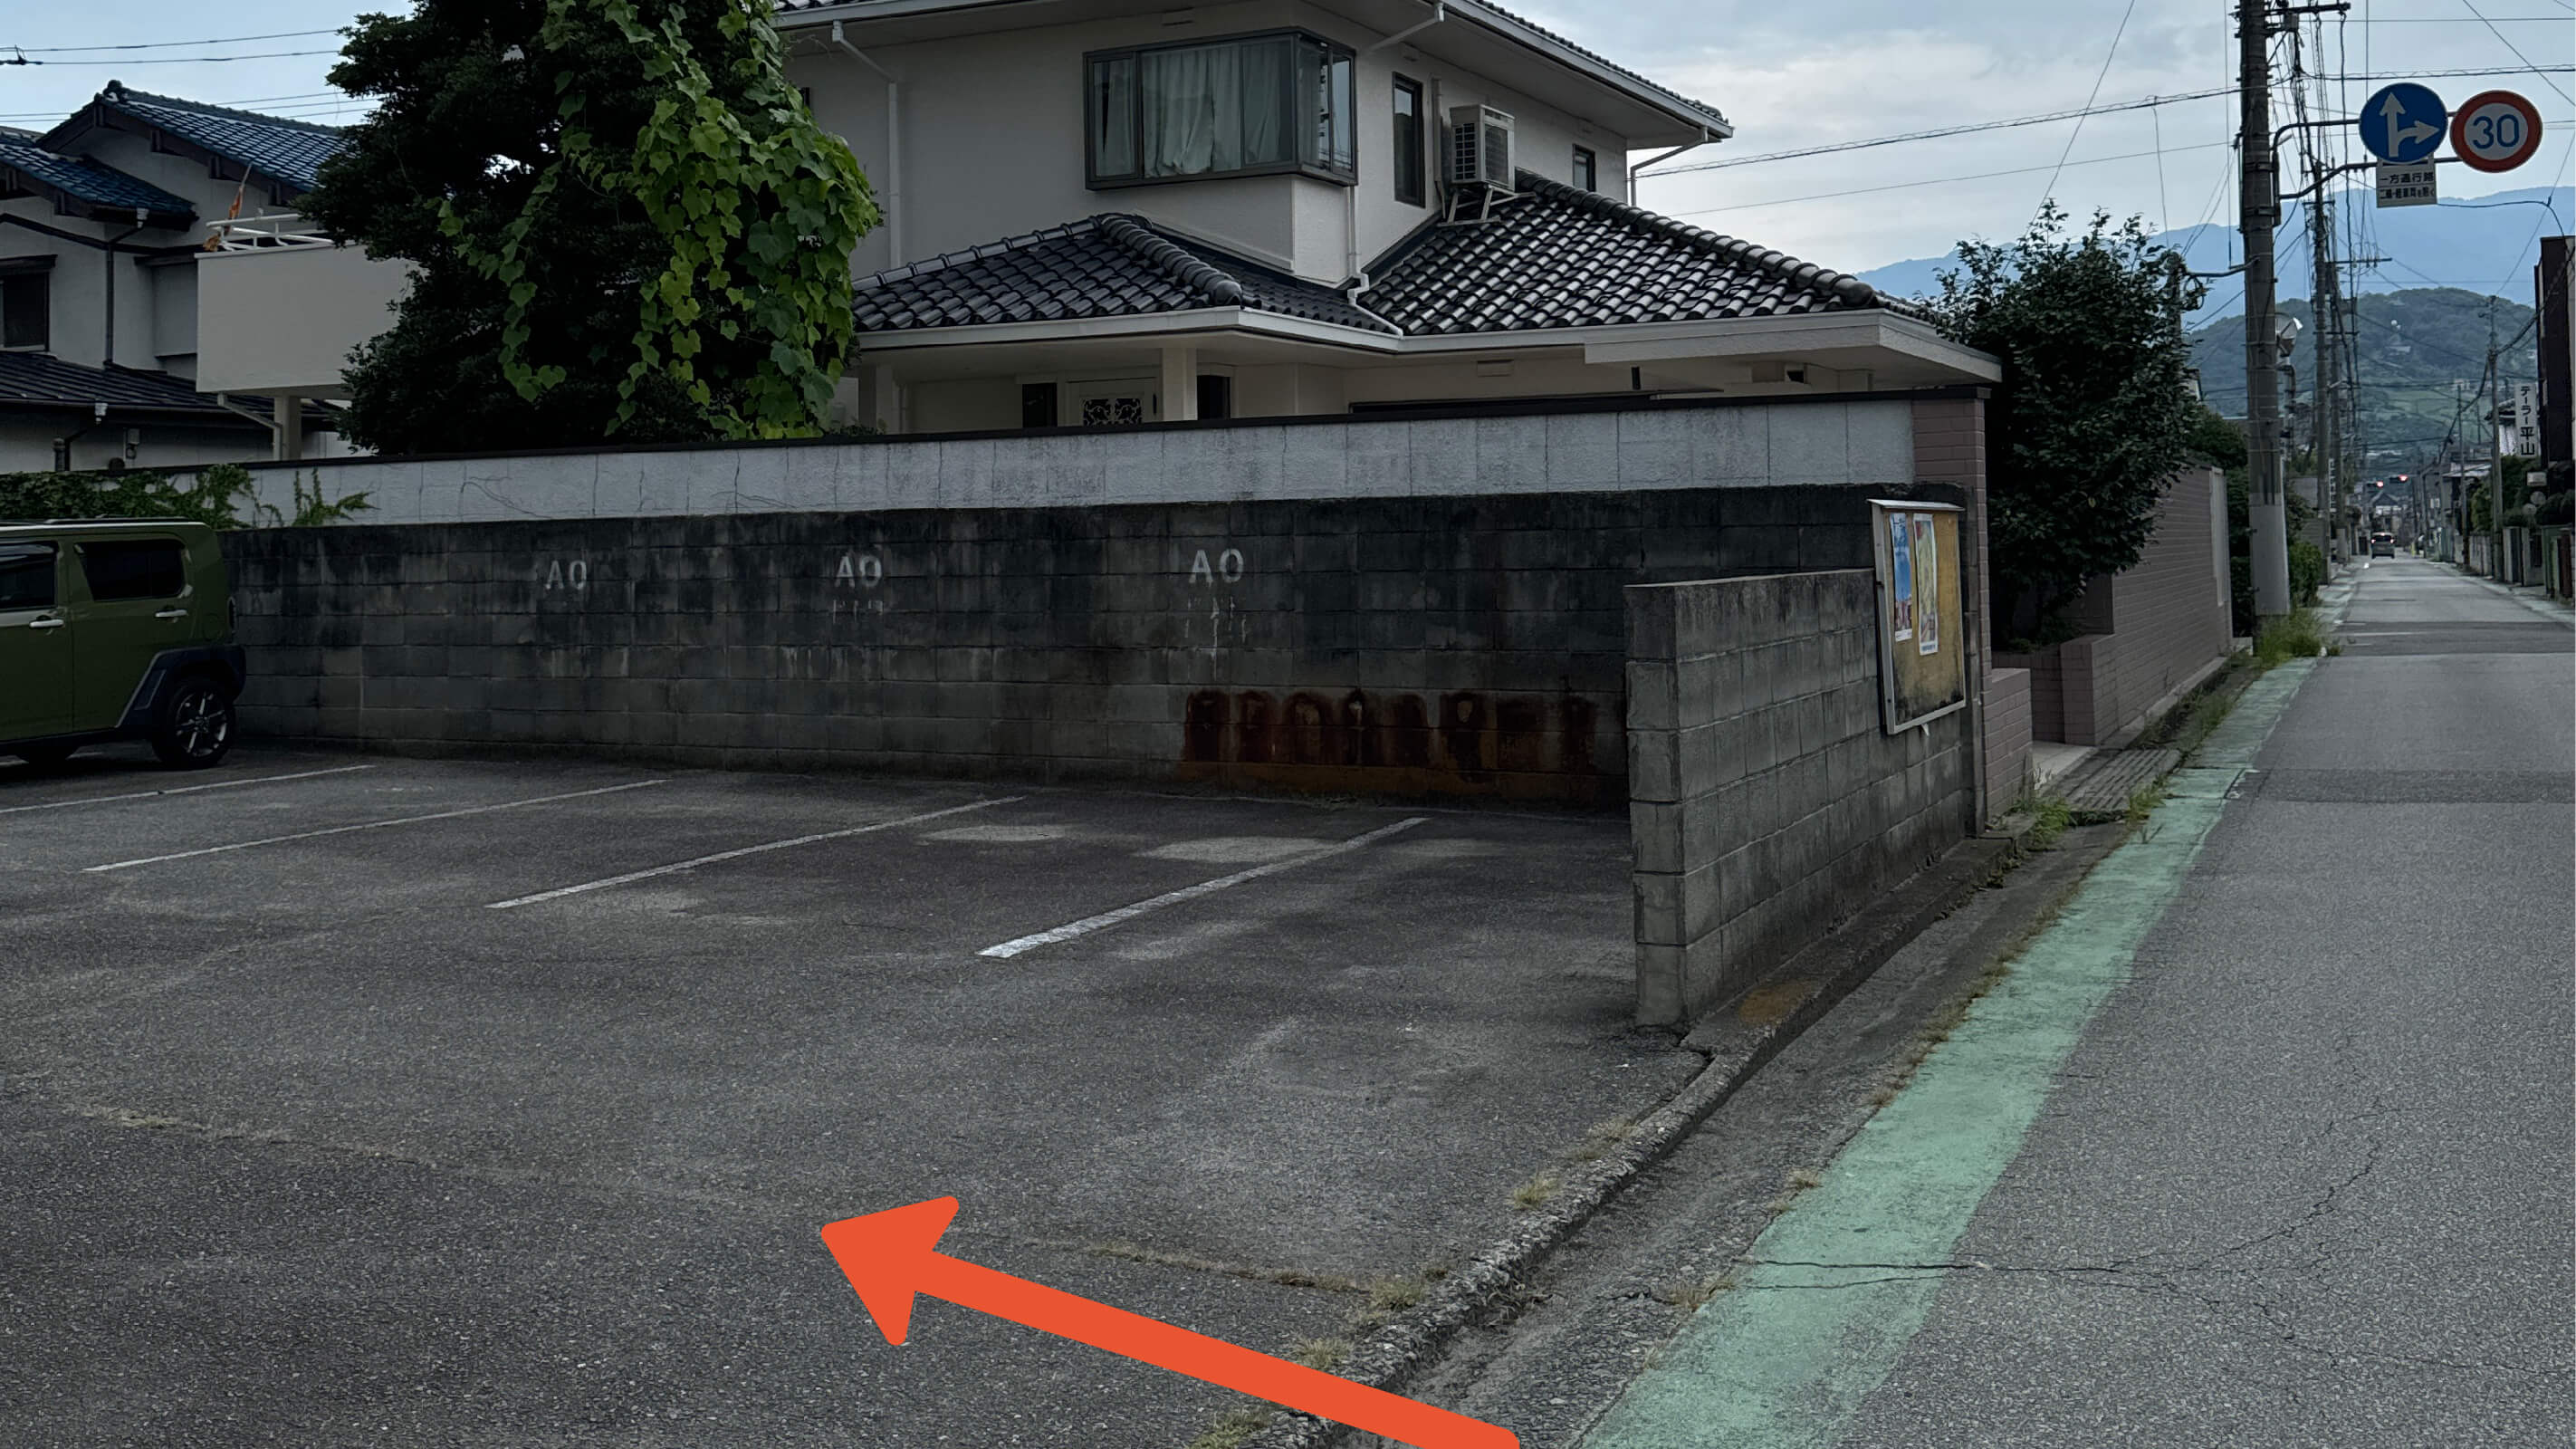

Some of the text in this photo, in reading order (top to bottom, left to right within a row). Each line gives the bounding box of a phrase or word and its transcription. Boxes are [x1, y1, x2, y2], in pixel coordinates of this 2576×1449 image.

[2473, 114, 2520, 149] 30
[2520, 386, 2535, 456] テーラー平山
